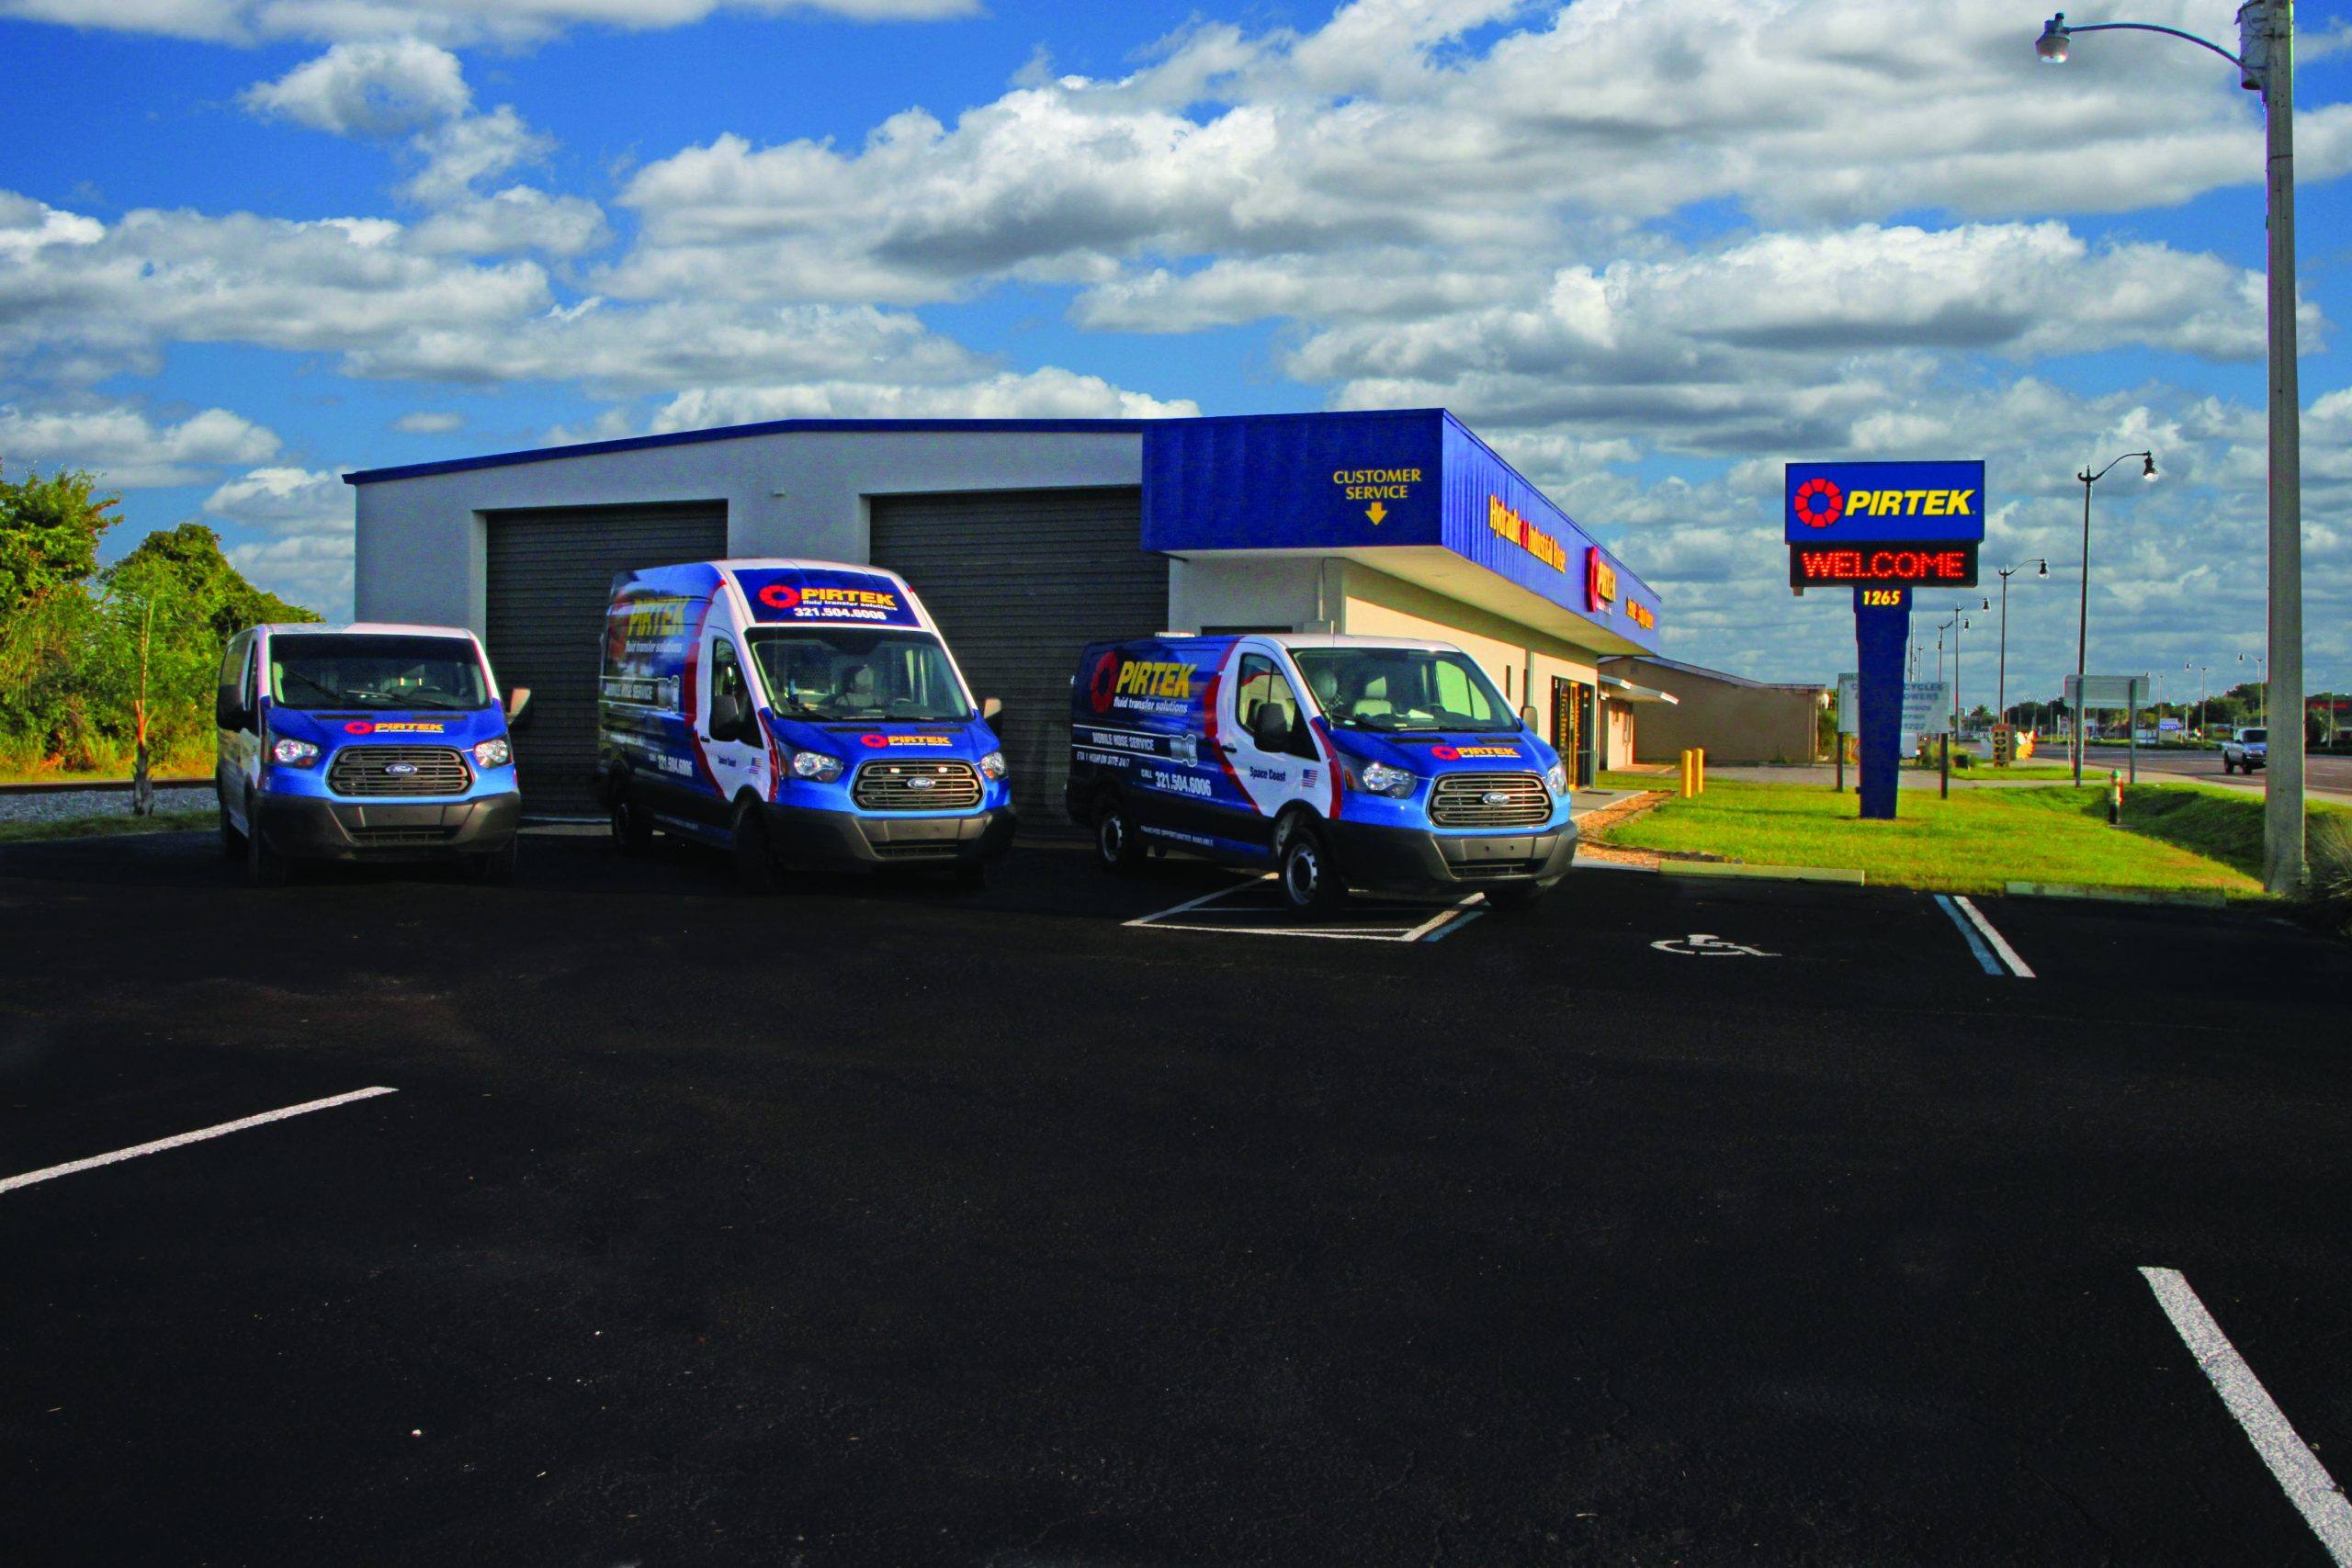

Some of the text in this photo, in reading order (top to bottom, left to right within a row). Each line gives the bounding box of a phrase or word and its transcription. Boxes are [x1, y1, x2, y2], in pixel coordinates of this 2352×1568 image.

[1333, 468, 1421, 484] CUSTOMER
[1345, 485, 1408, 500] SERVICE
[1845, 490, 1974, 515] PIRTEK
[1802, 551, 1965, 578] WELCOME
[801, 588, 895, 605] PIRTEK
[1863, 591, 1901, 605] 1265
[628, 597, 691, 637] PIRTEK
[794, 607, 887, 620] 321.504.6006
[1115, 660, 1198, 698] PIRTEK
[1114, 696, 1188, 714] fluid transfer solutions
[1129, 736, 1155, 750] SERVICE
[1456, 747, 1519, 755] PIRTEK
[1250, 766, 1286, 782] Space Coast
[1155, 771, 1212, 796] 321.504.6006
